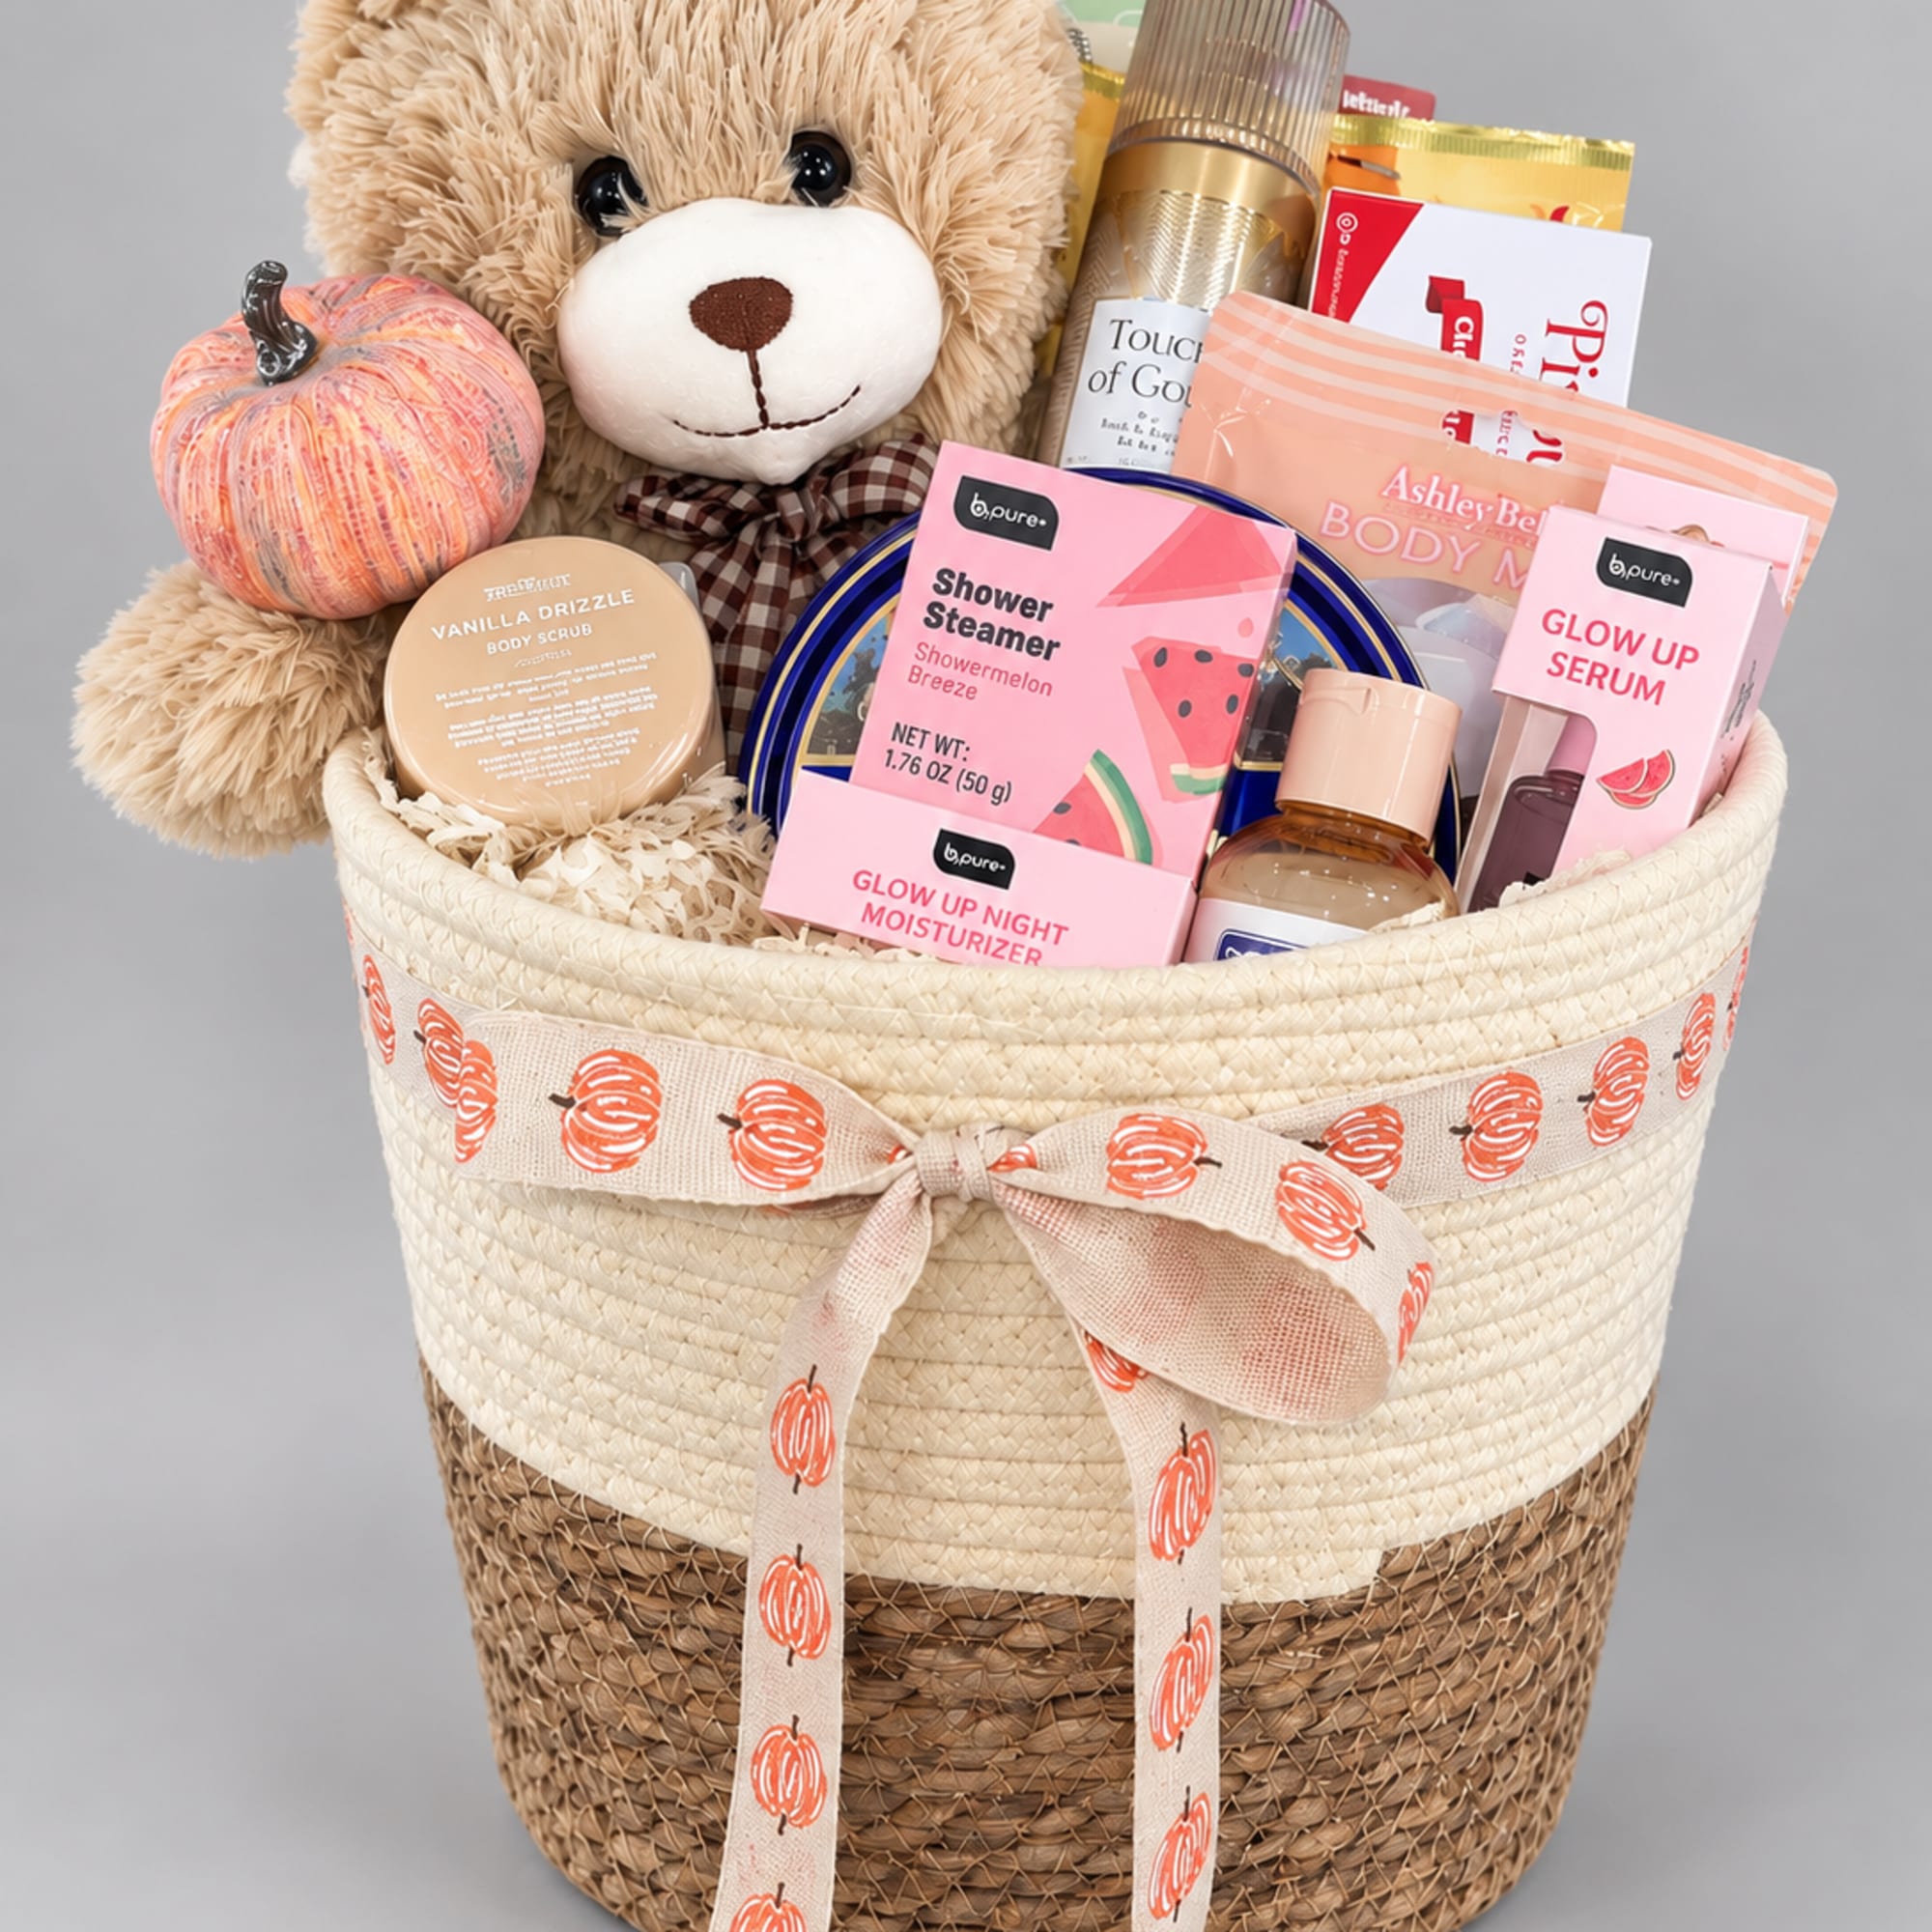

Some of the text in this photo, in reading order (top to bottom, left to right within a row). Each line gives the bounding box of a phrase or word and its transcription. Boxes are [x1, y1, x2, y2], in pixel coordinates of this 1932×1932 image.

[1088, 360, 1127, 394] of
[1381, 466, 1493, 529] Ashley
[1321, 501, 1481, 573] BODY
[431, 588, 635, 639] VANILLA DRIZZLE
[932, 568, 1054, 622] Shower
[487, 623, 593, 654] BODY SCRUB
[923, 601, 1061, 661] Steamer
[1542, 609, 1700, 669] GLOW UP
[907, 665, 978, 700] Breeze
[914, 641, 1054, 696] Showermelon
[1547, 651, 1666, 706] SERUM
[891, 722, 970, 761] NET WT:
[885, 749, 1011, 806] 1.76 OZ (50 g)
[852, 869, 1069, 946] GLOW UP NIGHT
[861, 902, 1043, 966] MOISTURIZER
